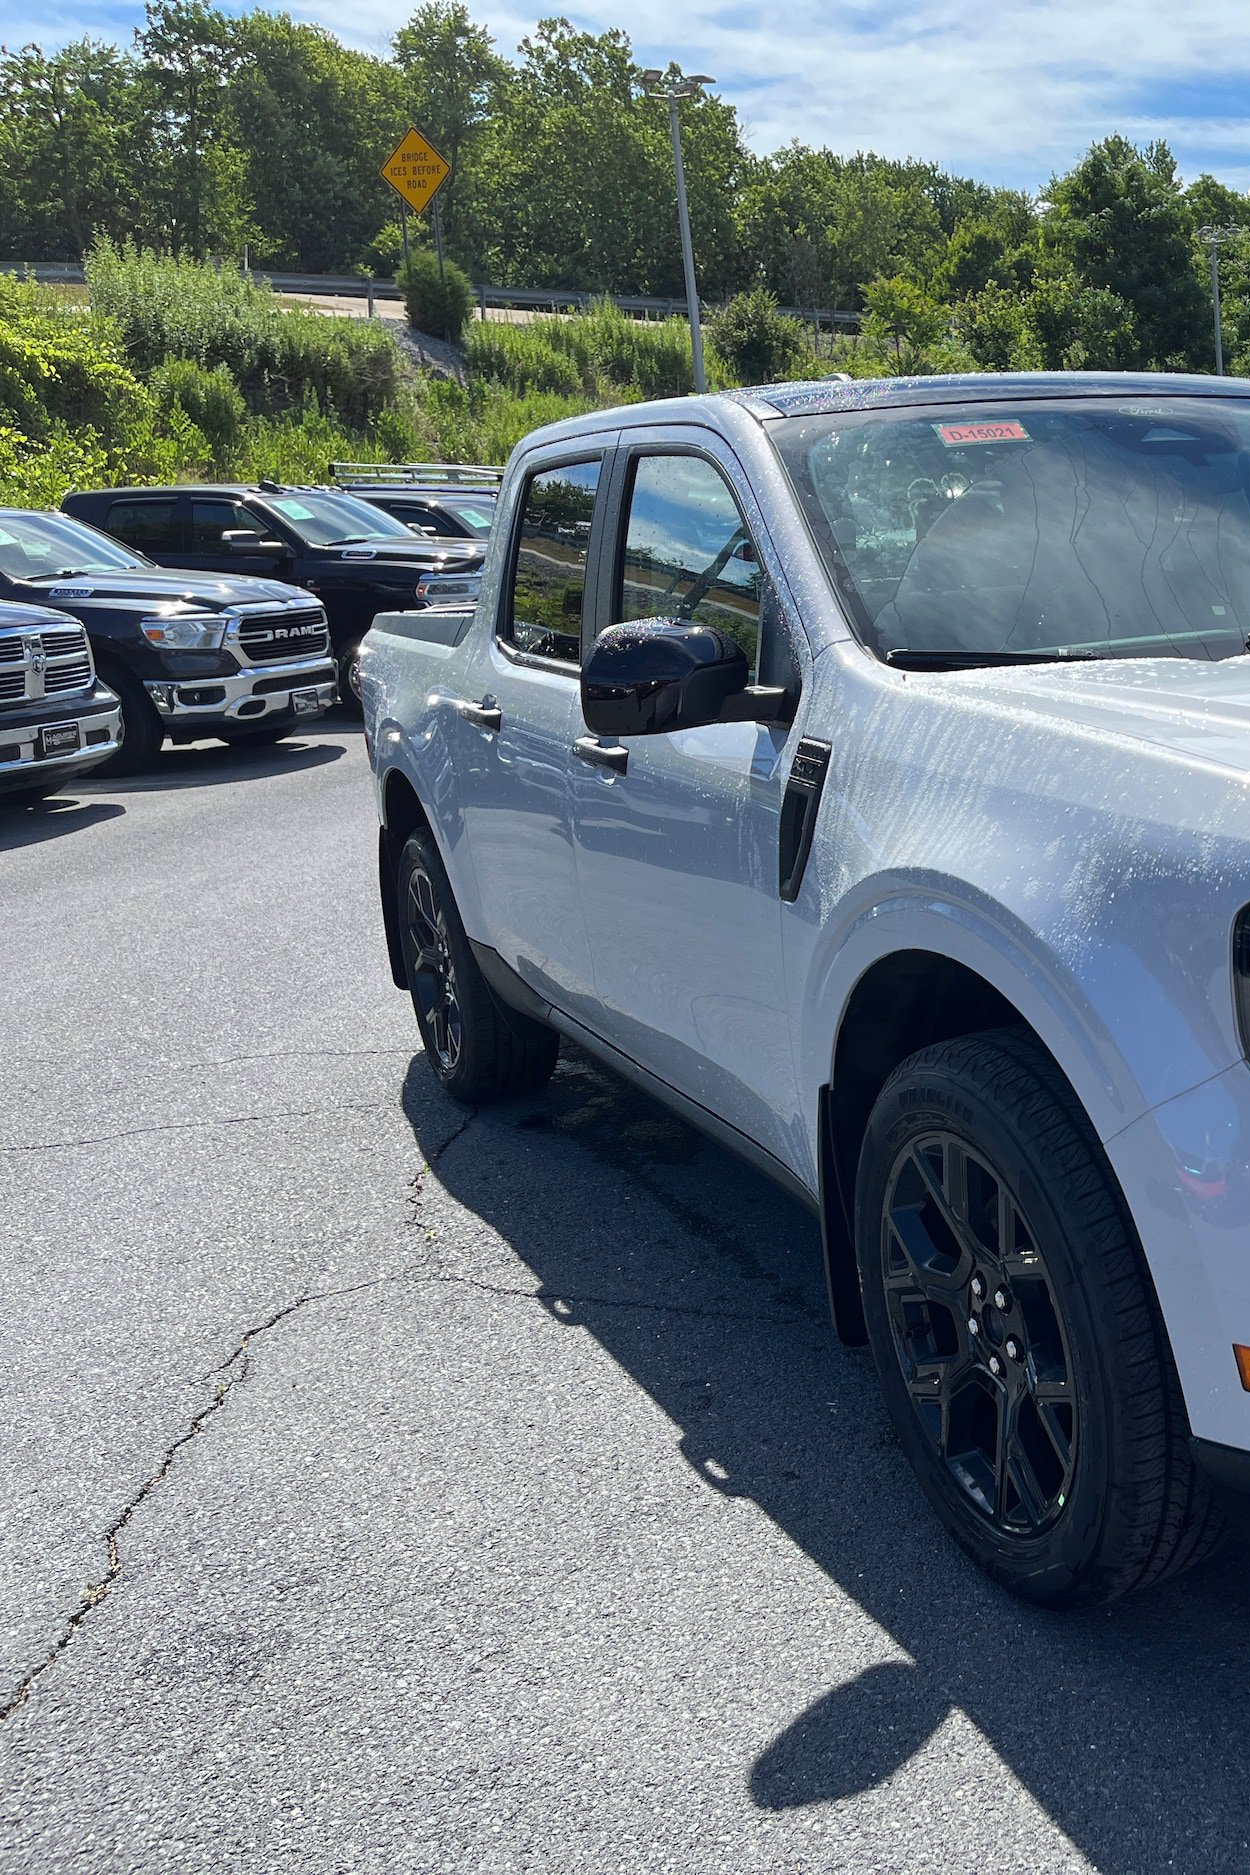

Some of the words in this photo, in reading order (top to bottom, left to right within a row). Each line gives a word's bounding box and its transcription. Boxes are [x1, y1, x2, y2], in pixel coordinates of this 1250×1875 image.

[401, 152, 429, 162] BRIDGE
[390, 166, 407, 176] ICES
[412, 165, 441, 175] BEFORE
[406, 179, 427, 189] ROAD
[949, 427, 1016, 441] D-15021
[275, 625, 312, 639] RAM
